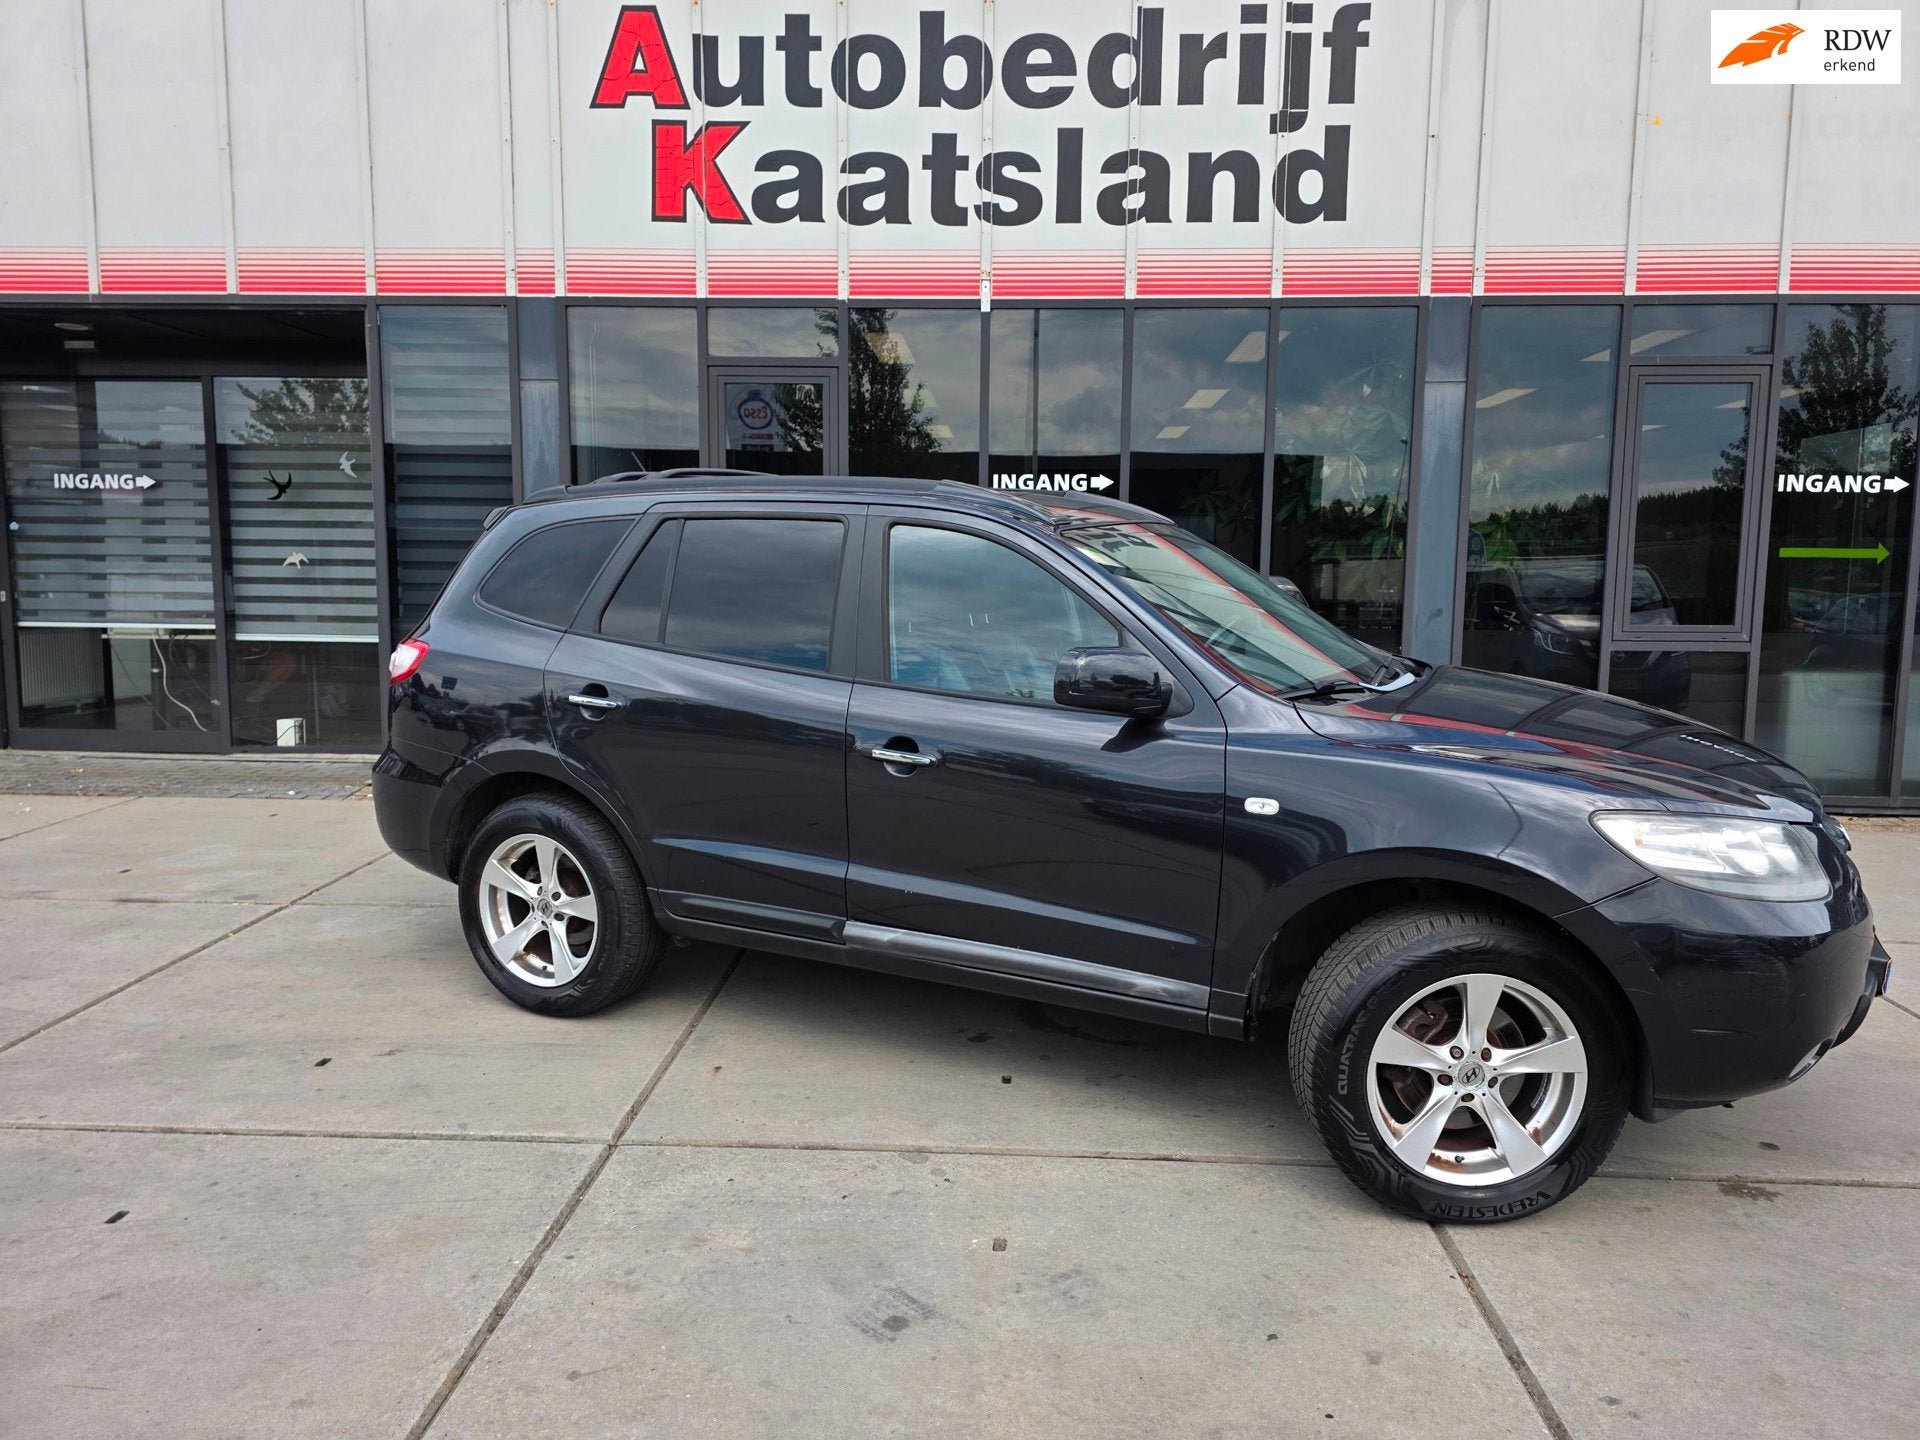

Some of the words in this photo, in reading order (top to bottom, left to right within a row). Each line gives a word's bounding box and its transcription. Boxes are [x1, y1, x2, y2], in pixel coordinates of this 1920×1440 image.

[590, 2, 1372, 134] Autobedrijf
[650, 120, 1350, 227] Kaatsland
[53, 473, 134, 490] INGANG
[991, 473, 1088, 492] INGANG
[1777, 474, 1882, 494] INGANG
[1430, 1190, 1553, 1219] VREDESTEIN
